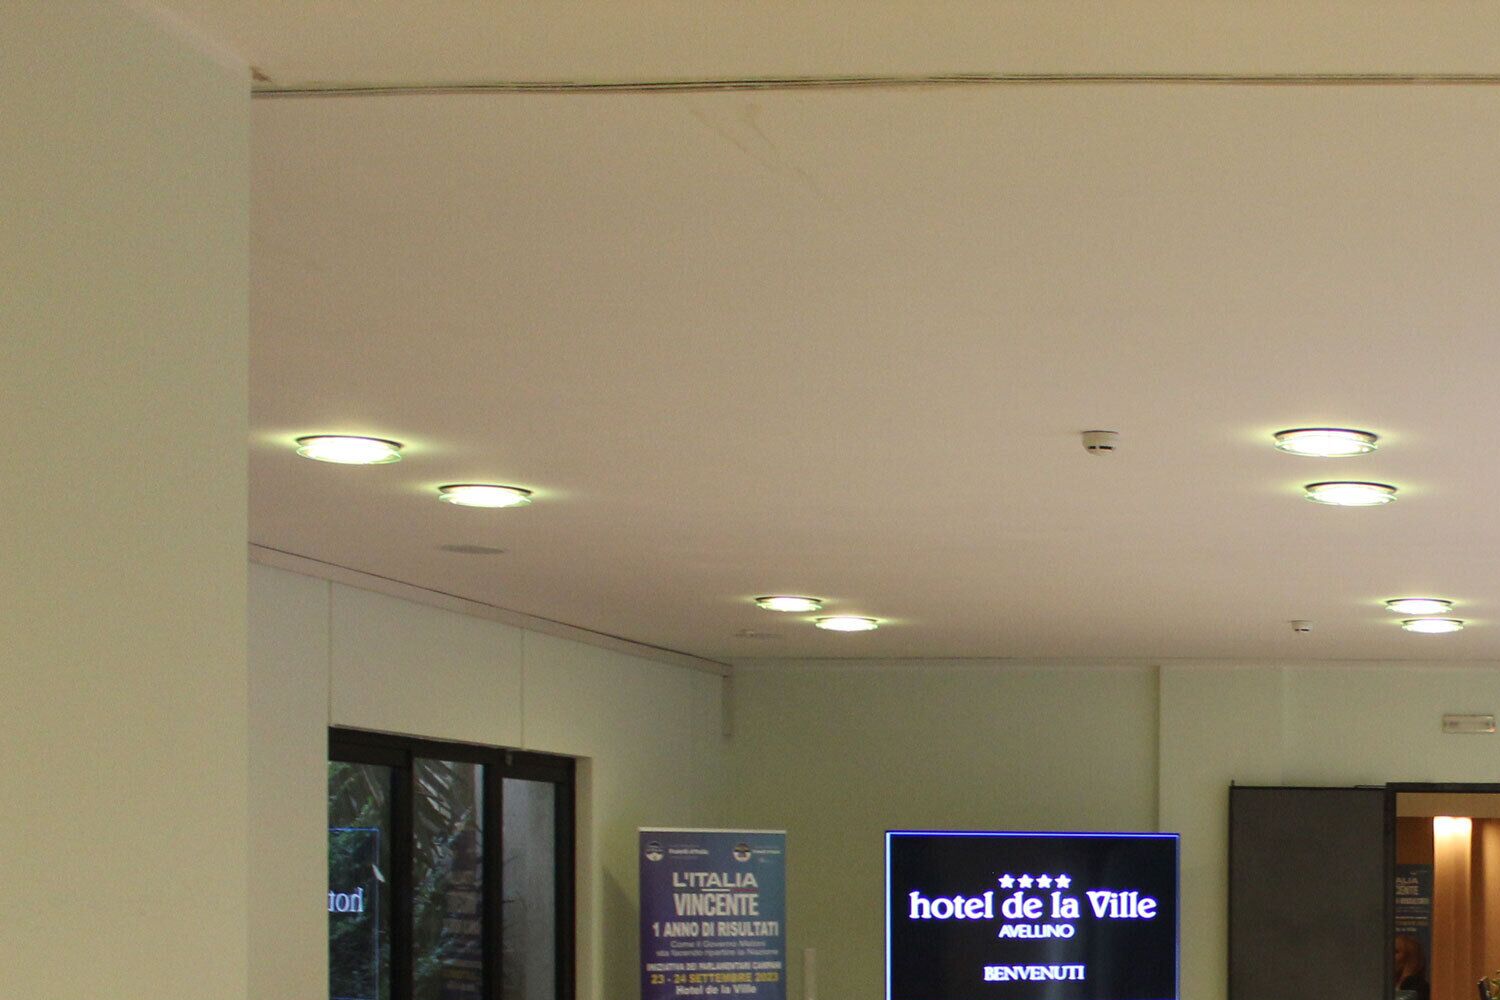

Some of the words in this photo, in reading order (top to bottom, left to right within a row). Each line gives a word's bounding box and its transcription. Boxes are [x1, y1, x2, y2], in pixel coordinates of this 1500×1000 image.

[673, 872, 758, 887] L'ITALIA
[673, 893, 759, 916] VINCENTE
[909, 891, 994, 919] hotel
[1001, 891, 1043, 919] de
[1051, 891, 1080, 918] la
[1086, 891, 1157, 918] Ville
[652, 922, 660, 937] 1
[663, 922, 699, 937] ANNO
[702, 921, 715, 937] DI
[717, 921, 779, 936] RISULTATI
[999, 924, 1075, 938] AVELLINO
[650, 974, 665, 984] 23
[688, 972, 752, 983] SETTEMBRE
[983, 965, 1085, 981] BENVENUTI
[675, 985, 703, 995] Hotel
[705, 985, 719, 995] de
[720, 984, 731, 994] la
[732, 984, 757, 994] Ville
